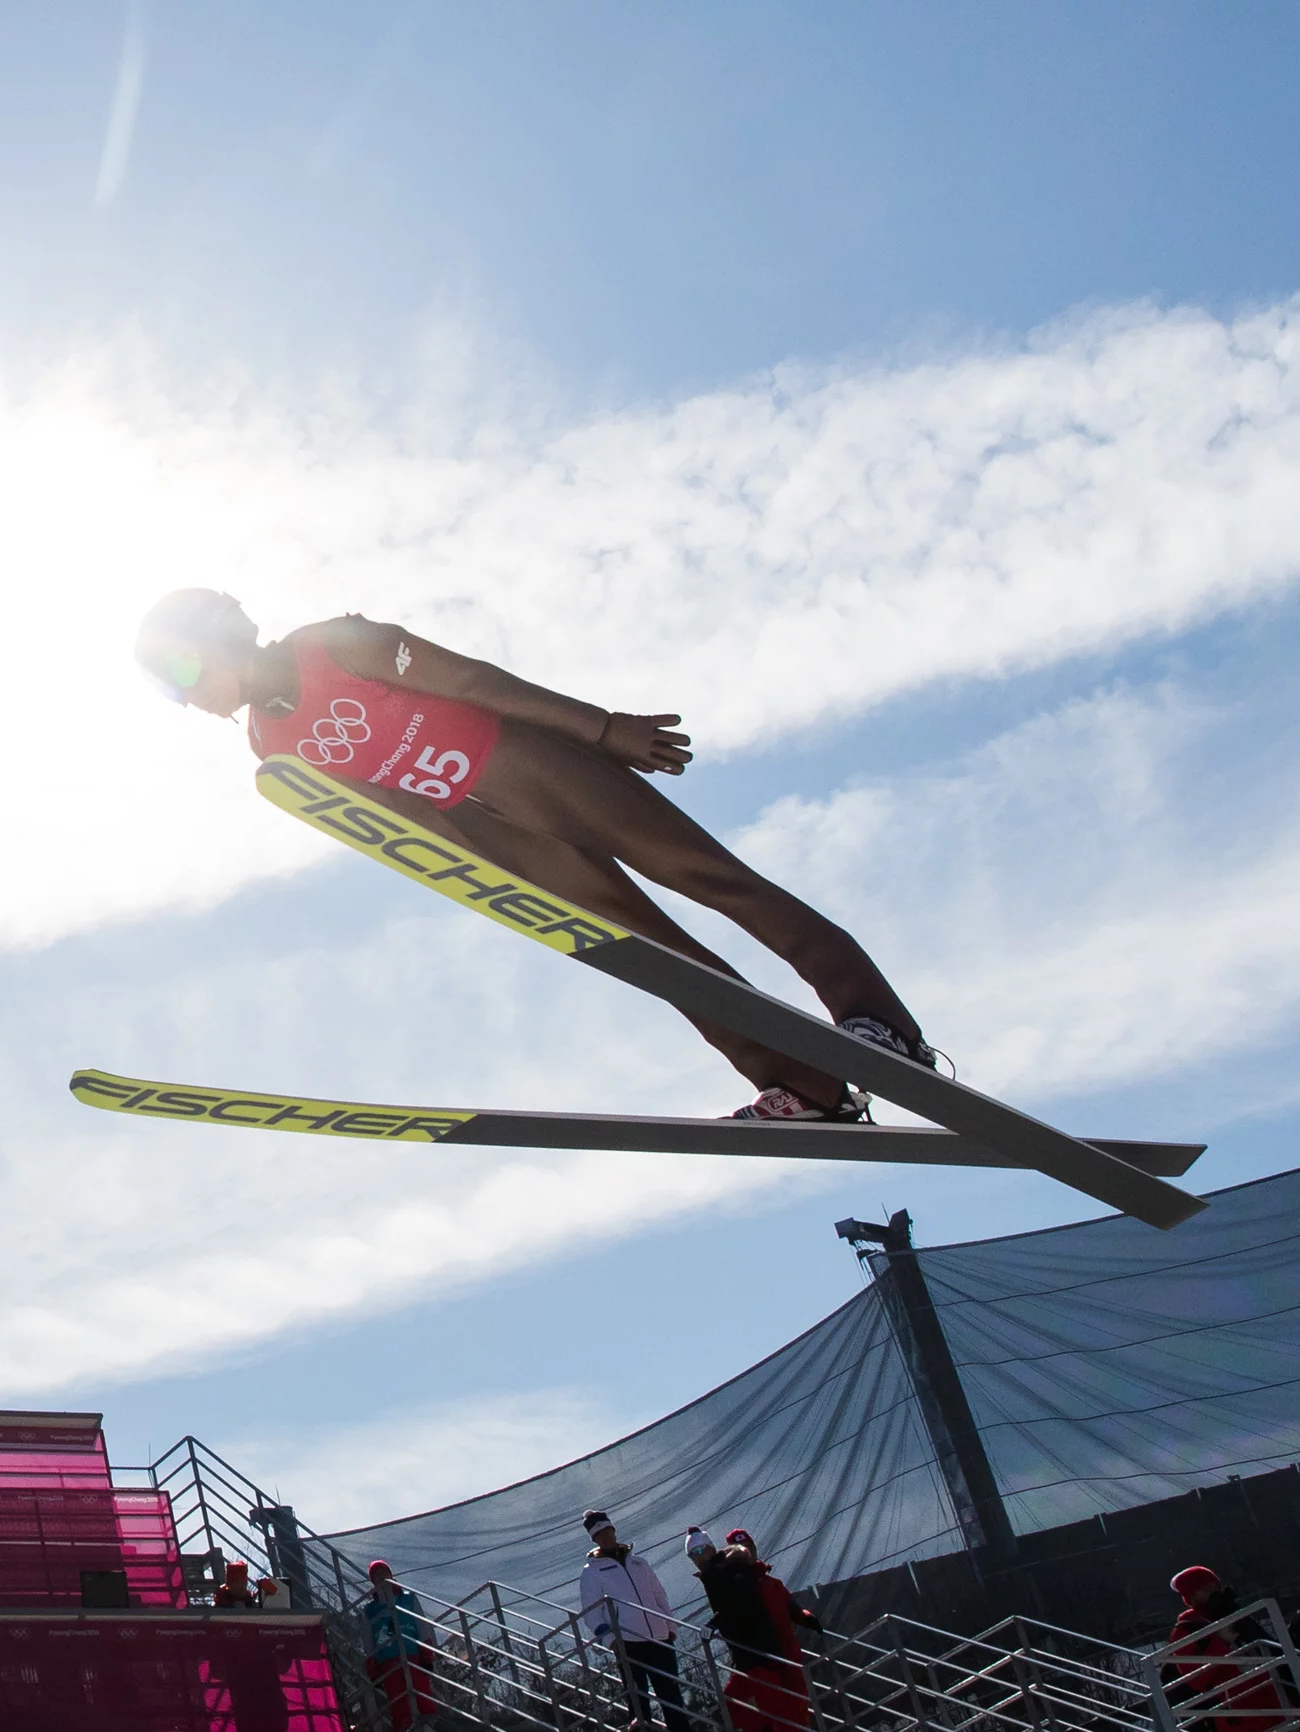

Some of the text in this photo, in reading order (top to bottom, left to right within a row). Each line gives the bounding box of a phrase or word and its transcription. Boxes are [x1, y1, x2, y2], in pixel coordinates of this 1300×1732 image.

[395, 640, 412, 676] 4F
[402, 713, 425, 745] 2018
[398, 745, 470, 799] 65
[257, 761, 615, 951] FISCHER
[69, 1077, 464, 1138] FISCHER
